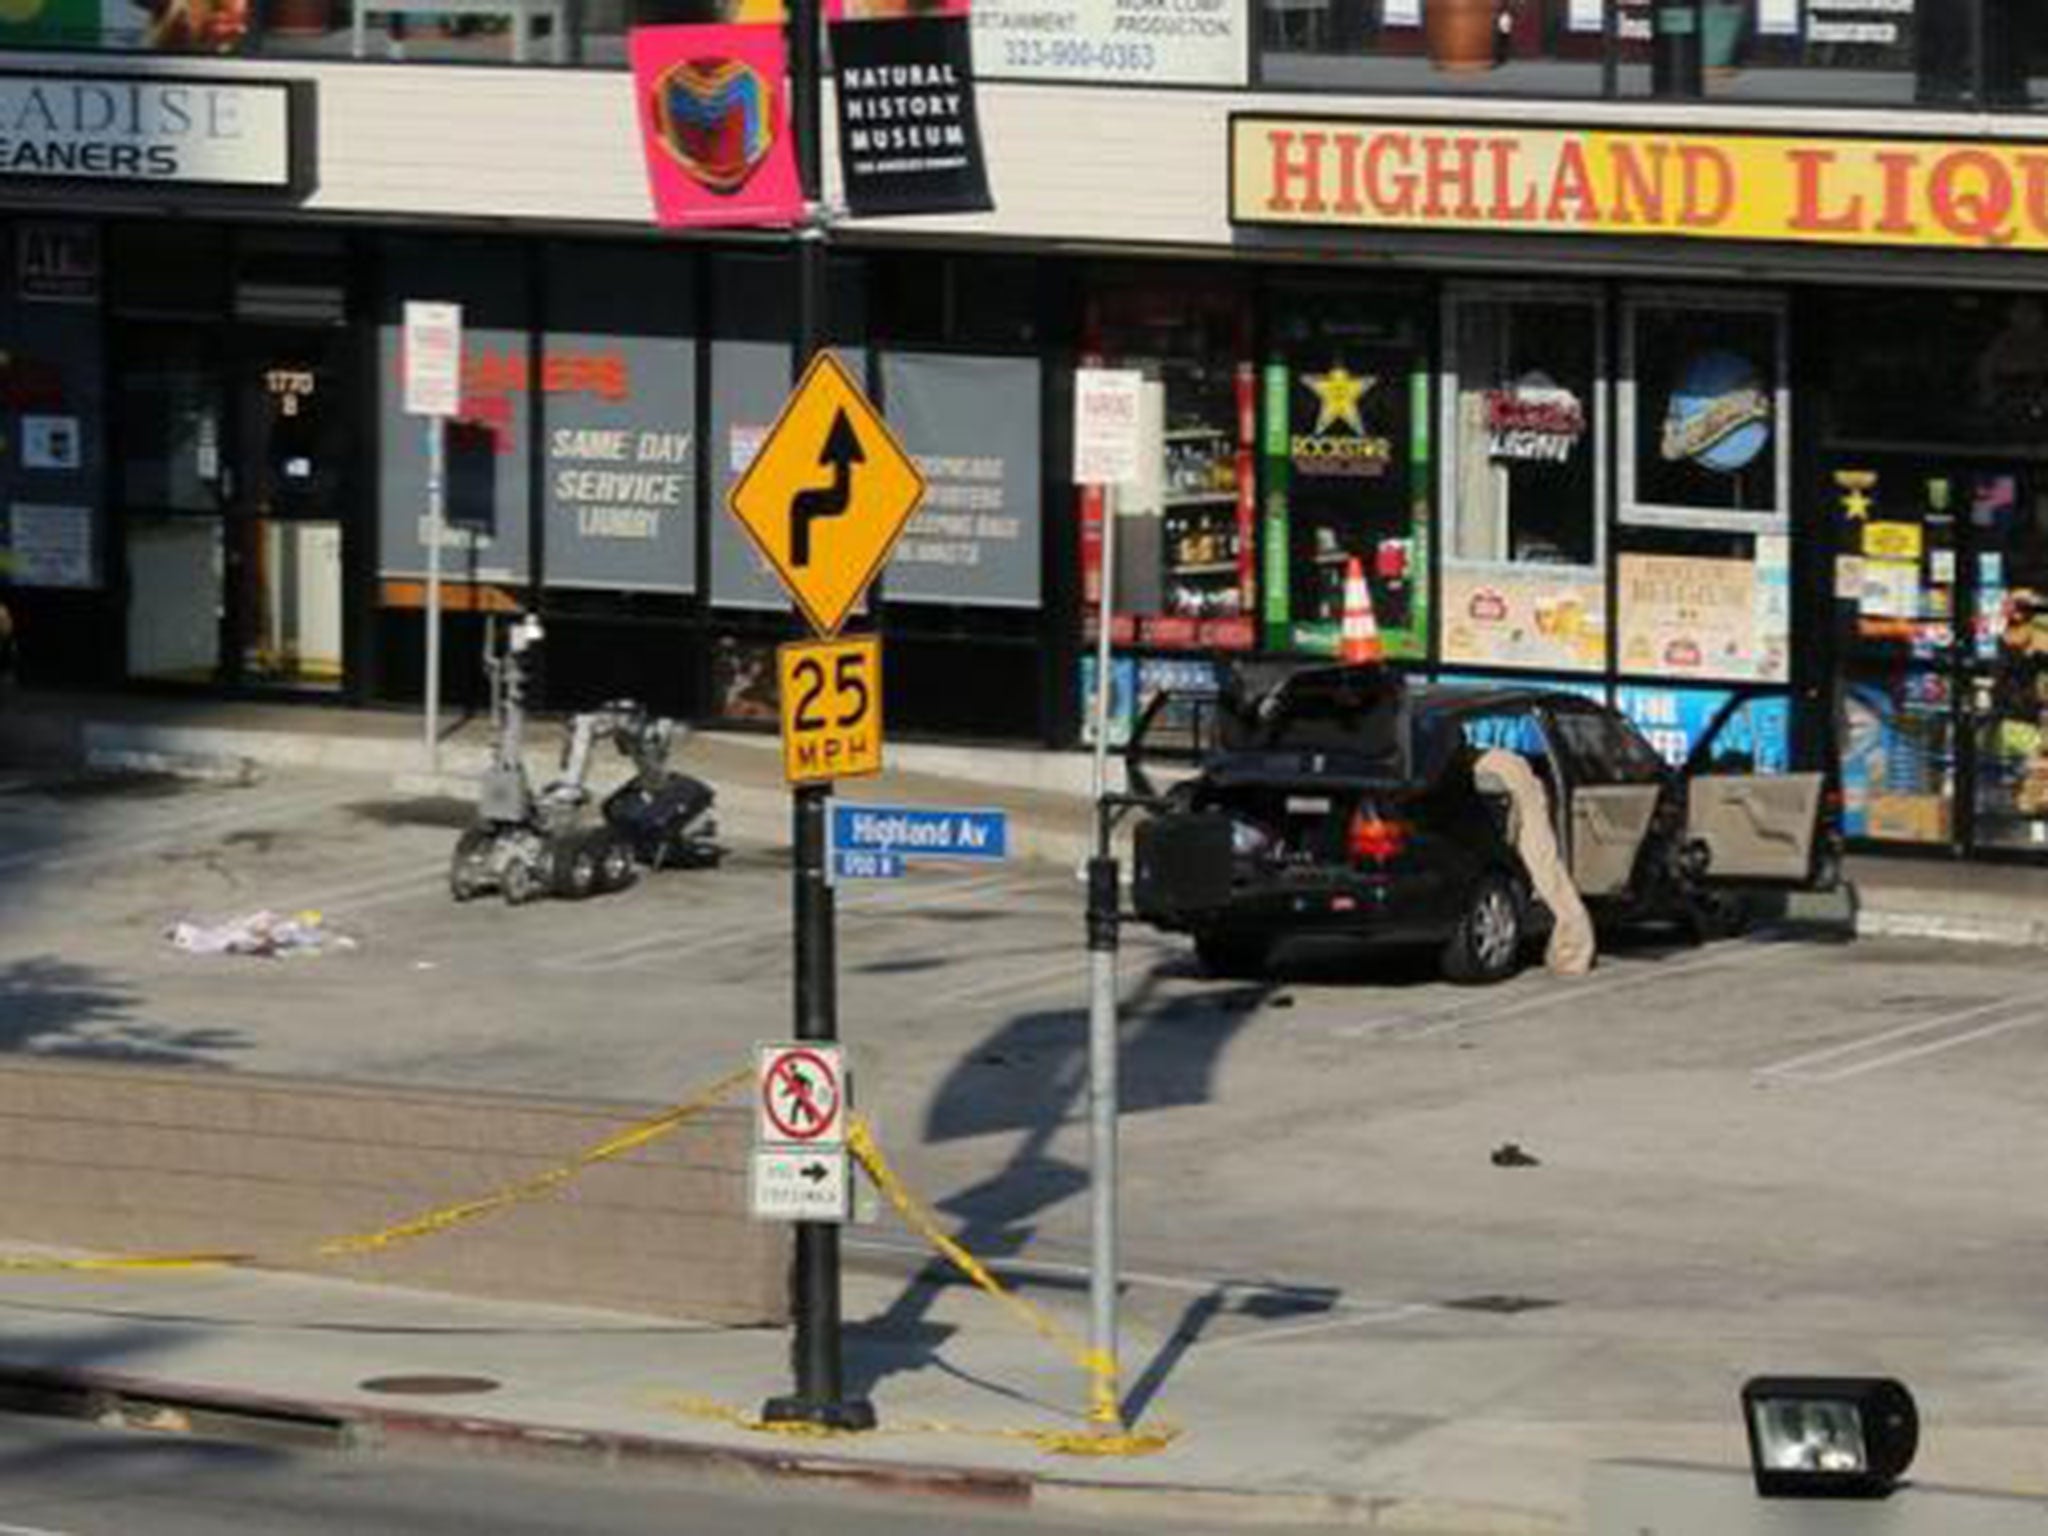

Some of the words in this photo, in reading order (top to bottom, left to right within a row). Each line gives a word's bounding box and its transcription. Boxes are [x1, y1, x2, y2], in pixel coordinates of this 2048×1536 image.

[1112, 15, 1232, 37] PRODUCTION
[843, 64, 959, 88] NATURAL
[0, 84, 244, 138] ADISE
[847, 94, 961, 119] HISTORY
[851, 124, 965, 150] MUSEUM
[1268, 131, 1736, 227] HIGHLAND
[551, 427, 631, 461] SAME
[635, 430, 692, 464] DAY
[555, 468, 682, 504] SERVICE
[792, 653, 869, 732] 25
[797, 737, 868, 769] MPH
[851, 812, 950, 851] Highland
[957, 816, 990, 847] Av
